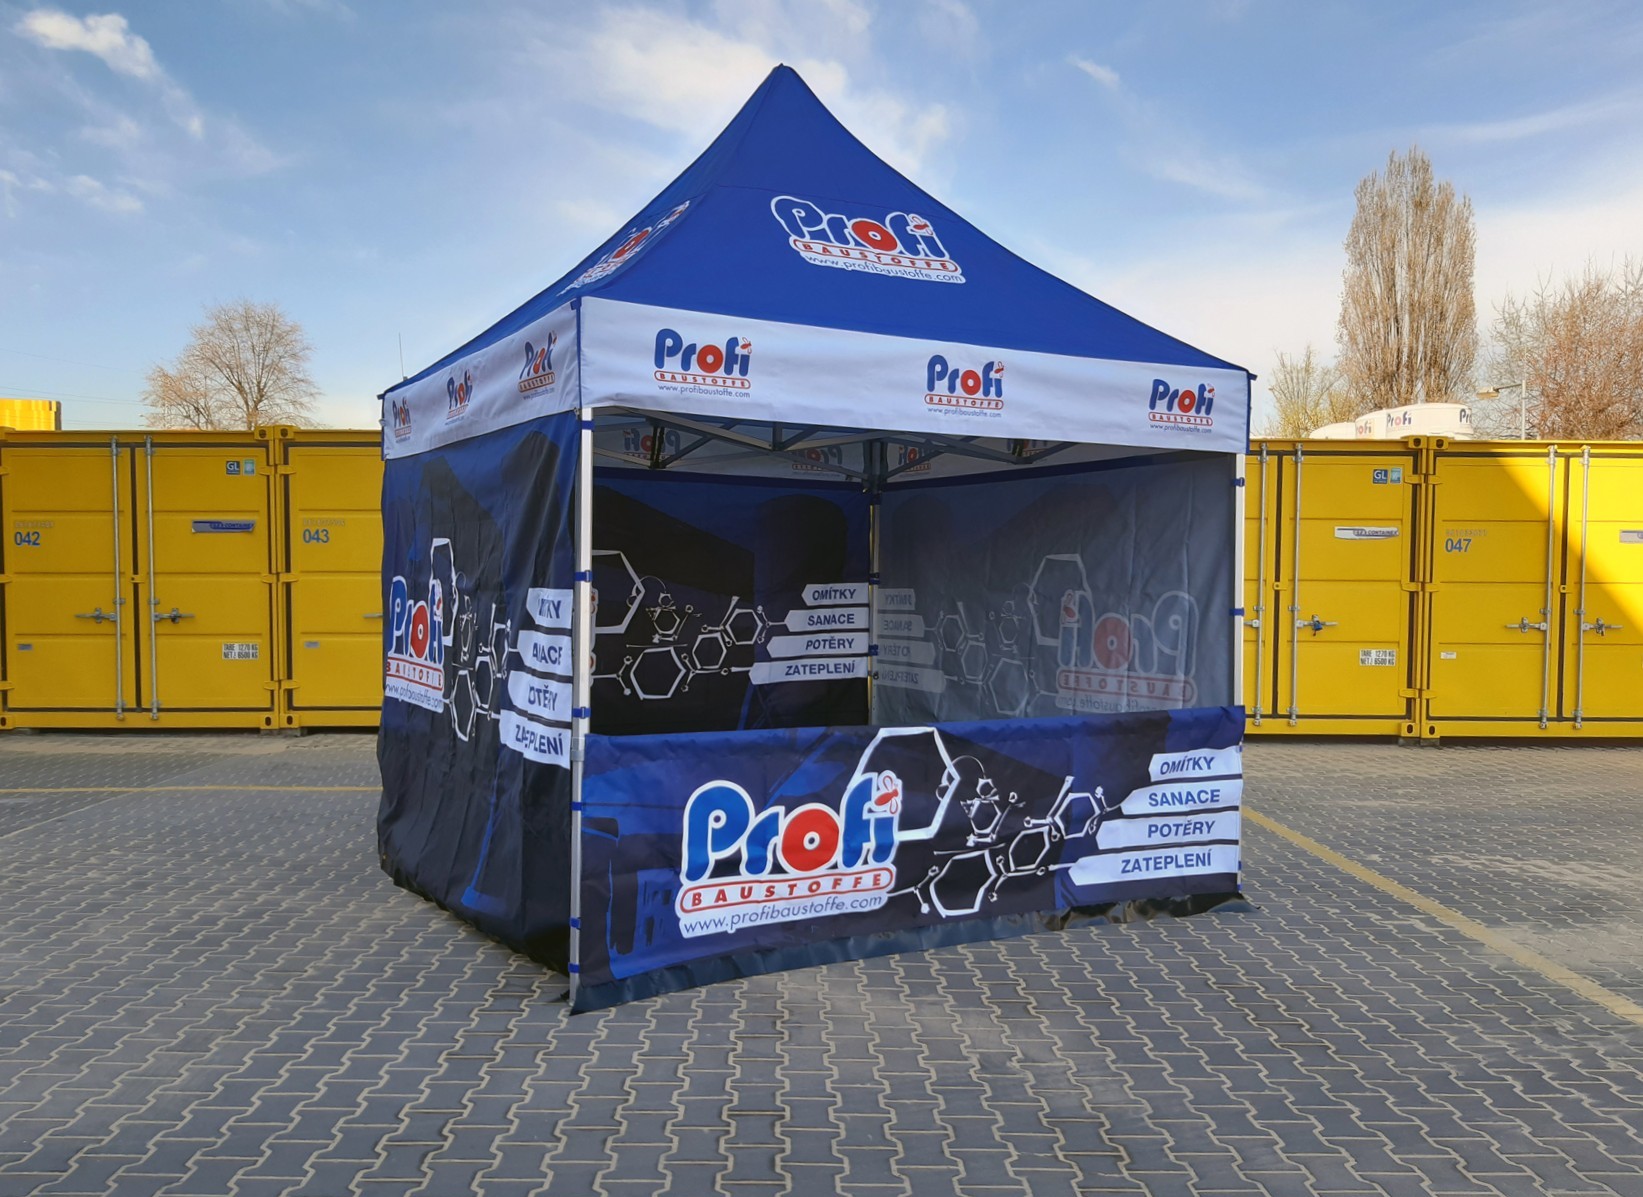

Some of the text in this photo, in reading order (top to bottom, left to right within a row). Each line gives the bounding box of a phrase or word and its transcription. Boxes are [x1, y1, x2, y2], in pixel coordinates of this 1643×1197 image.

[771, 196, 949, 261] Profi
[802, 243, 950, 270] BAUSTOFFE
[805, 254, 963, 283] www.profibaustoffe.com
[654, 328, 752, 377] Profi
[659, 372, 746, 388] BAUSTOFFE
[927, 354, 1005, 399] Profi
[657, 384, 750, 398] www.profibaustoffe.com
[1149, 378, 1216, 416] Profi
[928, 395, 1000, 409] BAUSTOFFE
[927, 407, 1002, 418] www.profibaustoffe.com
[1151, 412, 1210, 426] BAUSTOFFE
[1387, 411, 1412, 427] Profi
[1149, 422, 1212, 434] www.profibaustoffe.com
[226, 461, 240, 471] GL
[1373, 469, 1387, 480] GL
[14, 531, 41, 546] 042
[303, 528, 330, 543] 043
[1445, 537, 1472, 553] 047
[812, 586, 857, 601] OMÍTKY
[387, 576, 444, 665] Profi
[807, 613, 855, 626] SANACE
[805, 636, 855, 651] POTĚRY
[785, 660, 856, 676] ZATEPLENÍ
[1374, 657, 1387, 665] 6500
[1160, 755, 1215, 775] OMÍTKY
[1148, 789, 1221, 807] SANACE
[683, 774, 900, 882] Profi
[1147, 819, 1216, 839] POTĚRY
[1121, 848, 1213, 874] ZATEPLENÍ
[691, 873, 882, 908] BAUSTOFFE
[684, 895, 882, 933] www.profibaustoffe.com
